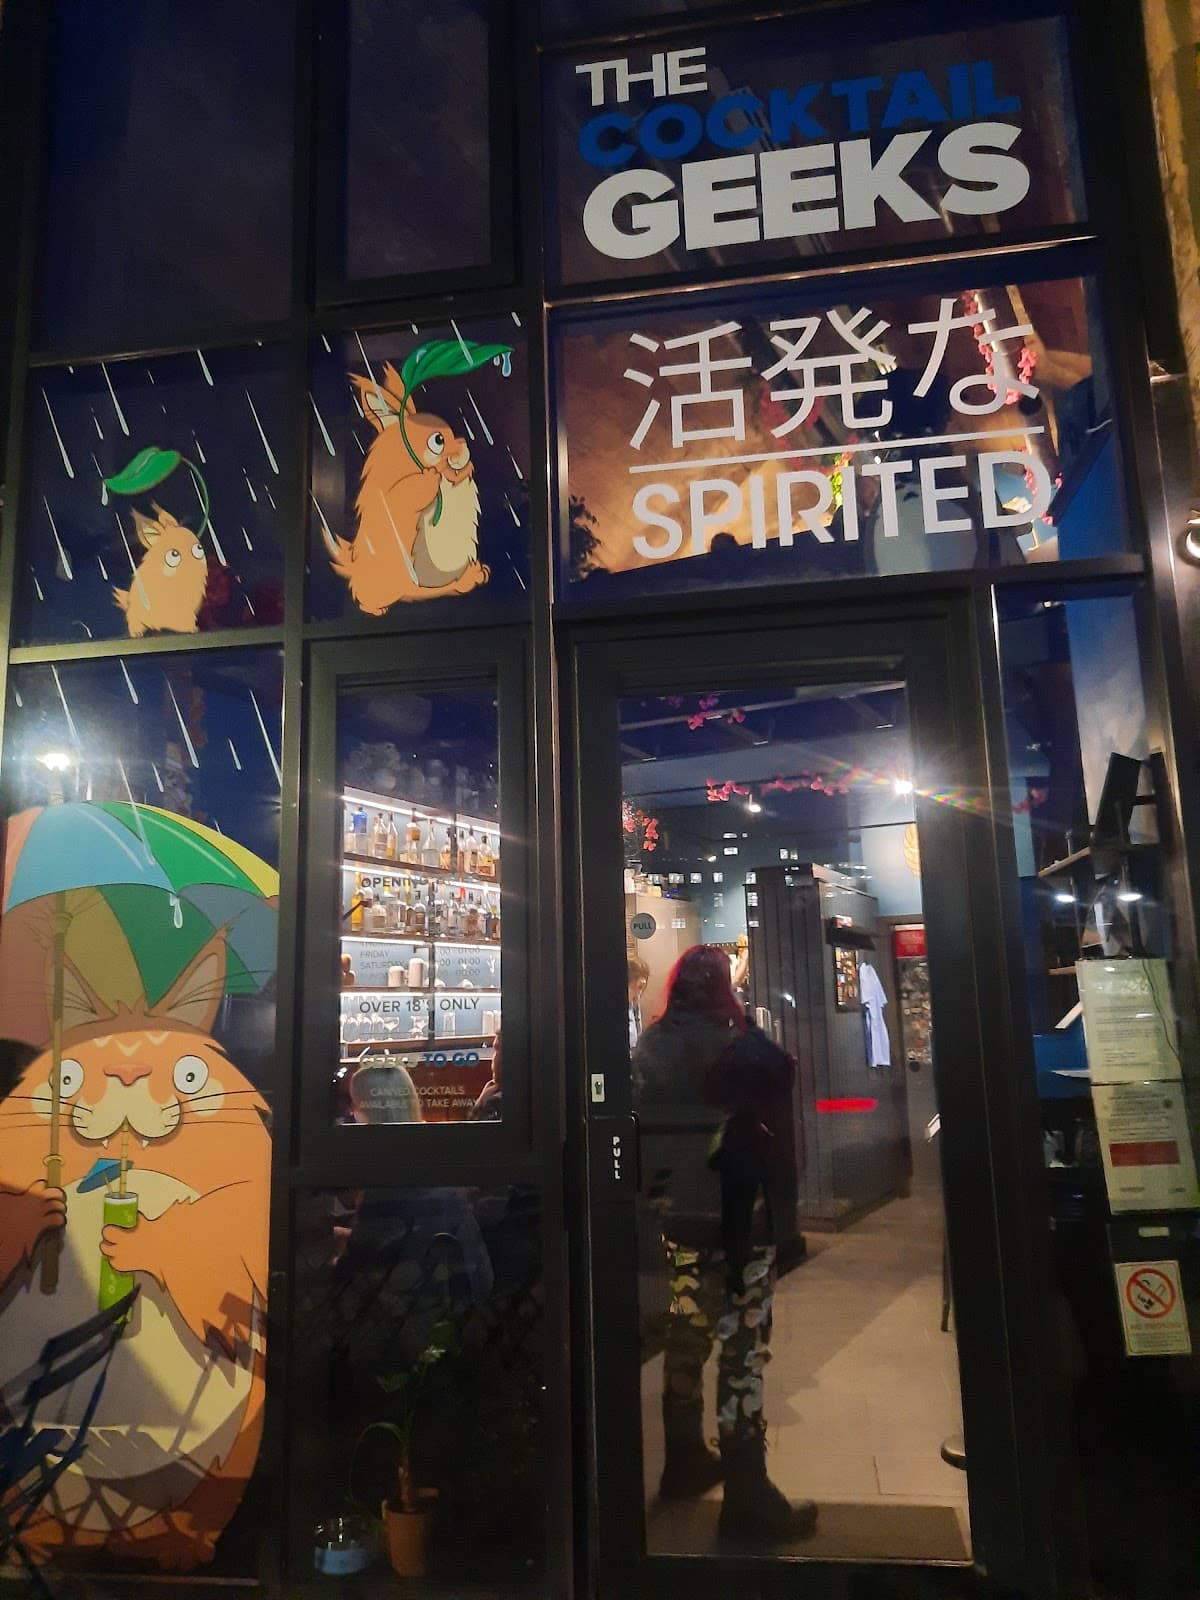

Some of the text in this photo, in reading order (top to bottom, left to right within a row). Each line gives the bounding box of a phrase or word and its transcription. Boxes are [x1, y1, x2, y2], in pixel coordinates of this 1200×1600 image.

[576, 47, 708, 106] THE
[579, 60, 1020, 168] COCKTAIL
[583, 122, 1030, 259] GEEKS
[623, 298, 1040, 450] 活発な
[632, 452, 1051, 560] SPIRITED
[360, 1000, 400, 1013] OVER
[440, 998, 480, 1010] ONLY
[423, 1052, 447, 1067] TO
[452, 1051, 480, 1067] GO
[427, 1098, 450, 1107] TAKE
[612, 1136, 621, 1180] PULL
